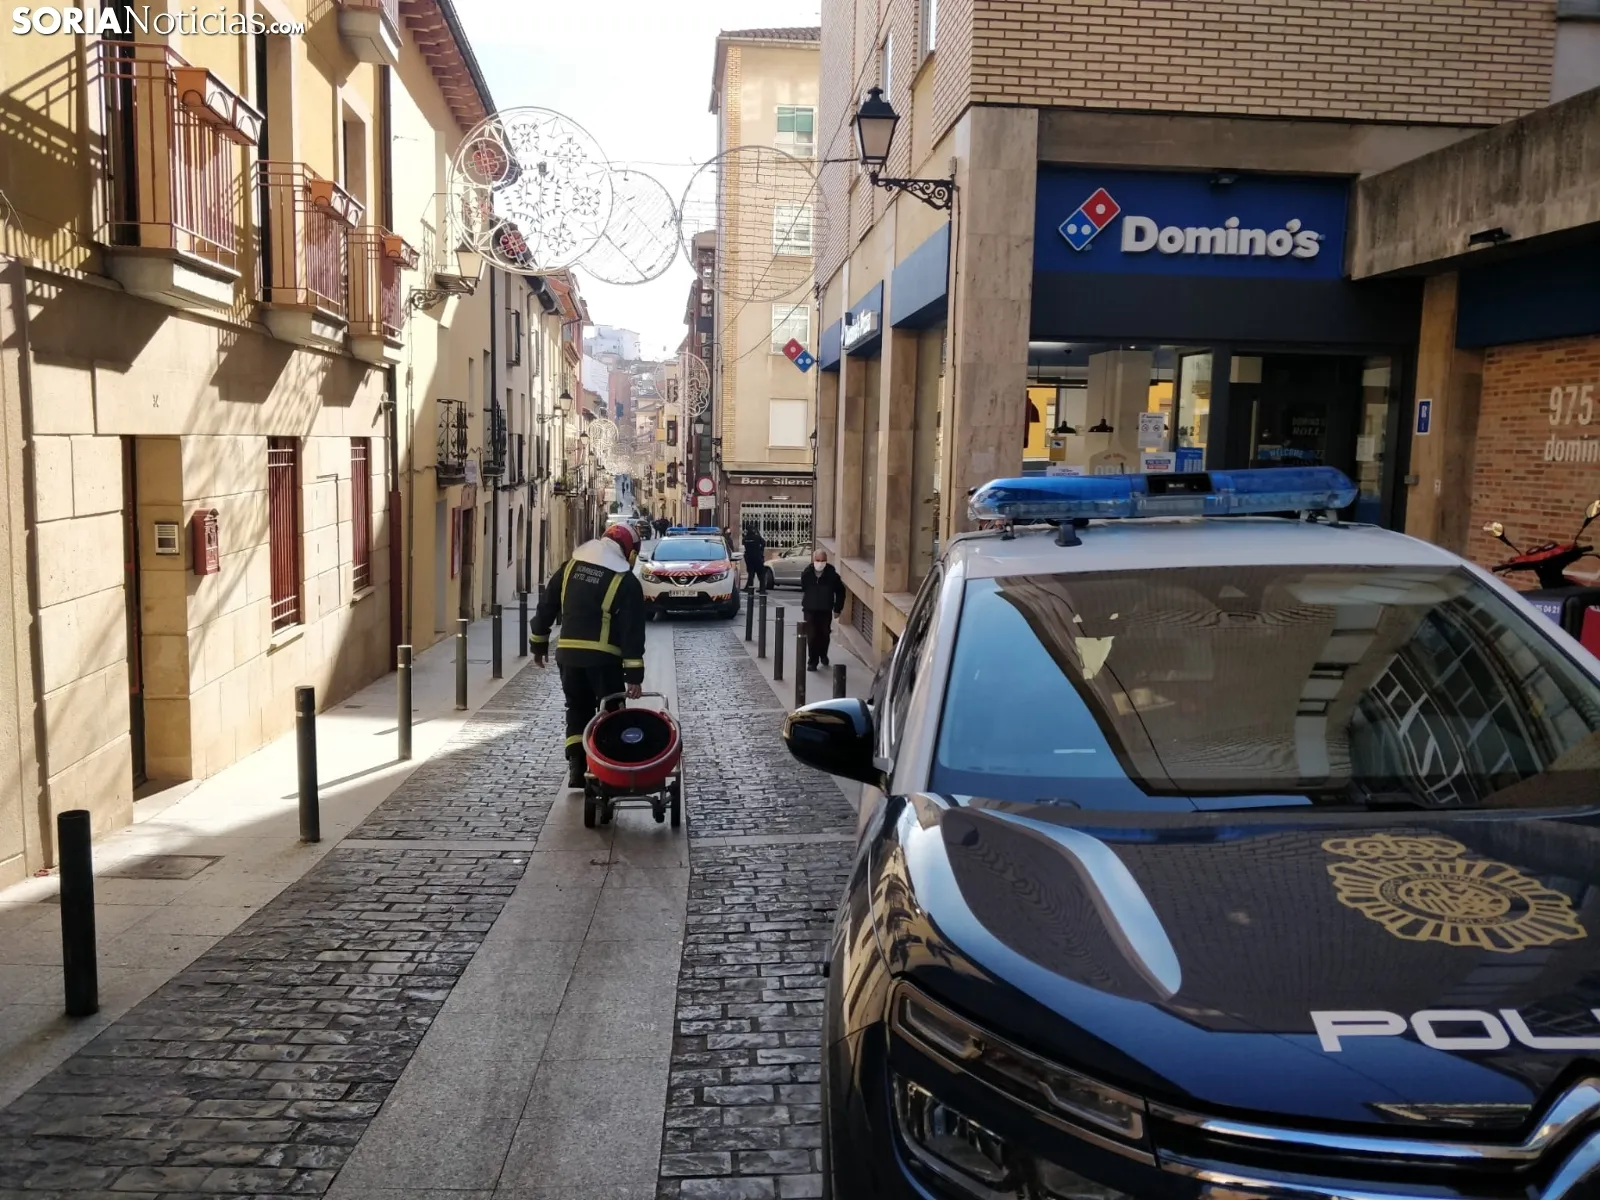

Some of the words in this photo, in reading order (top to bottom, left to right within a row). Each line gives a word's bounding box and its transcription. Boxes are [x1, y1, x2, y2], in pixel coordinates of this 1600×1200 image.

[1120, 216, 1320, 258] Domino's
[1549, 385, 1594, 426] 975
[1270, 447, 1304, 458] WELCOME
[1544, 434, 1600, 462] domin
[740, 477, 767, 485] Bar
